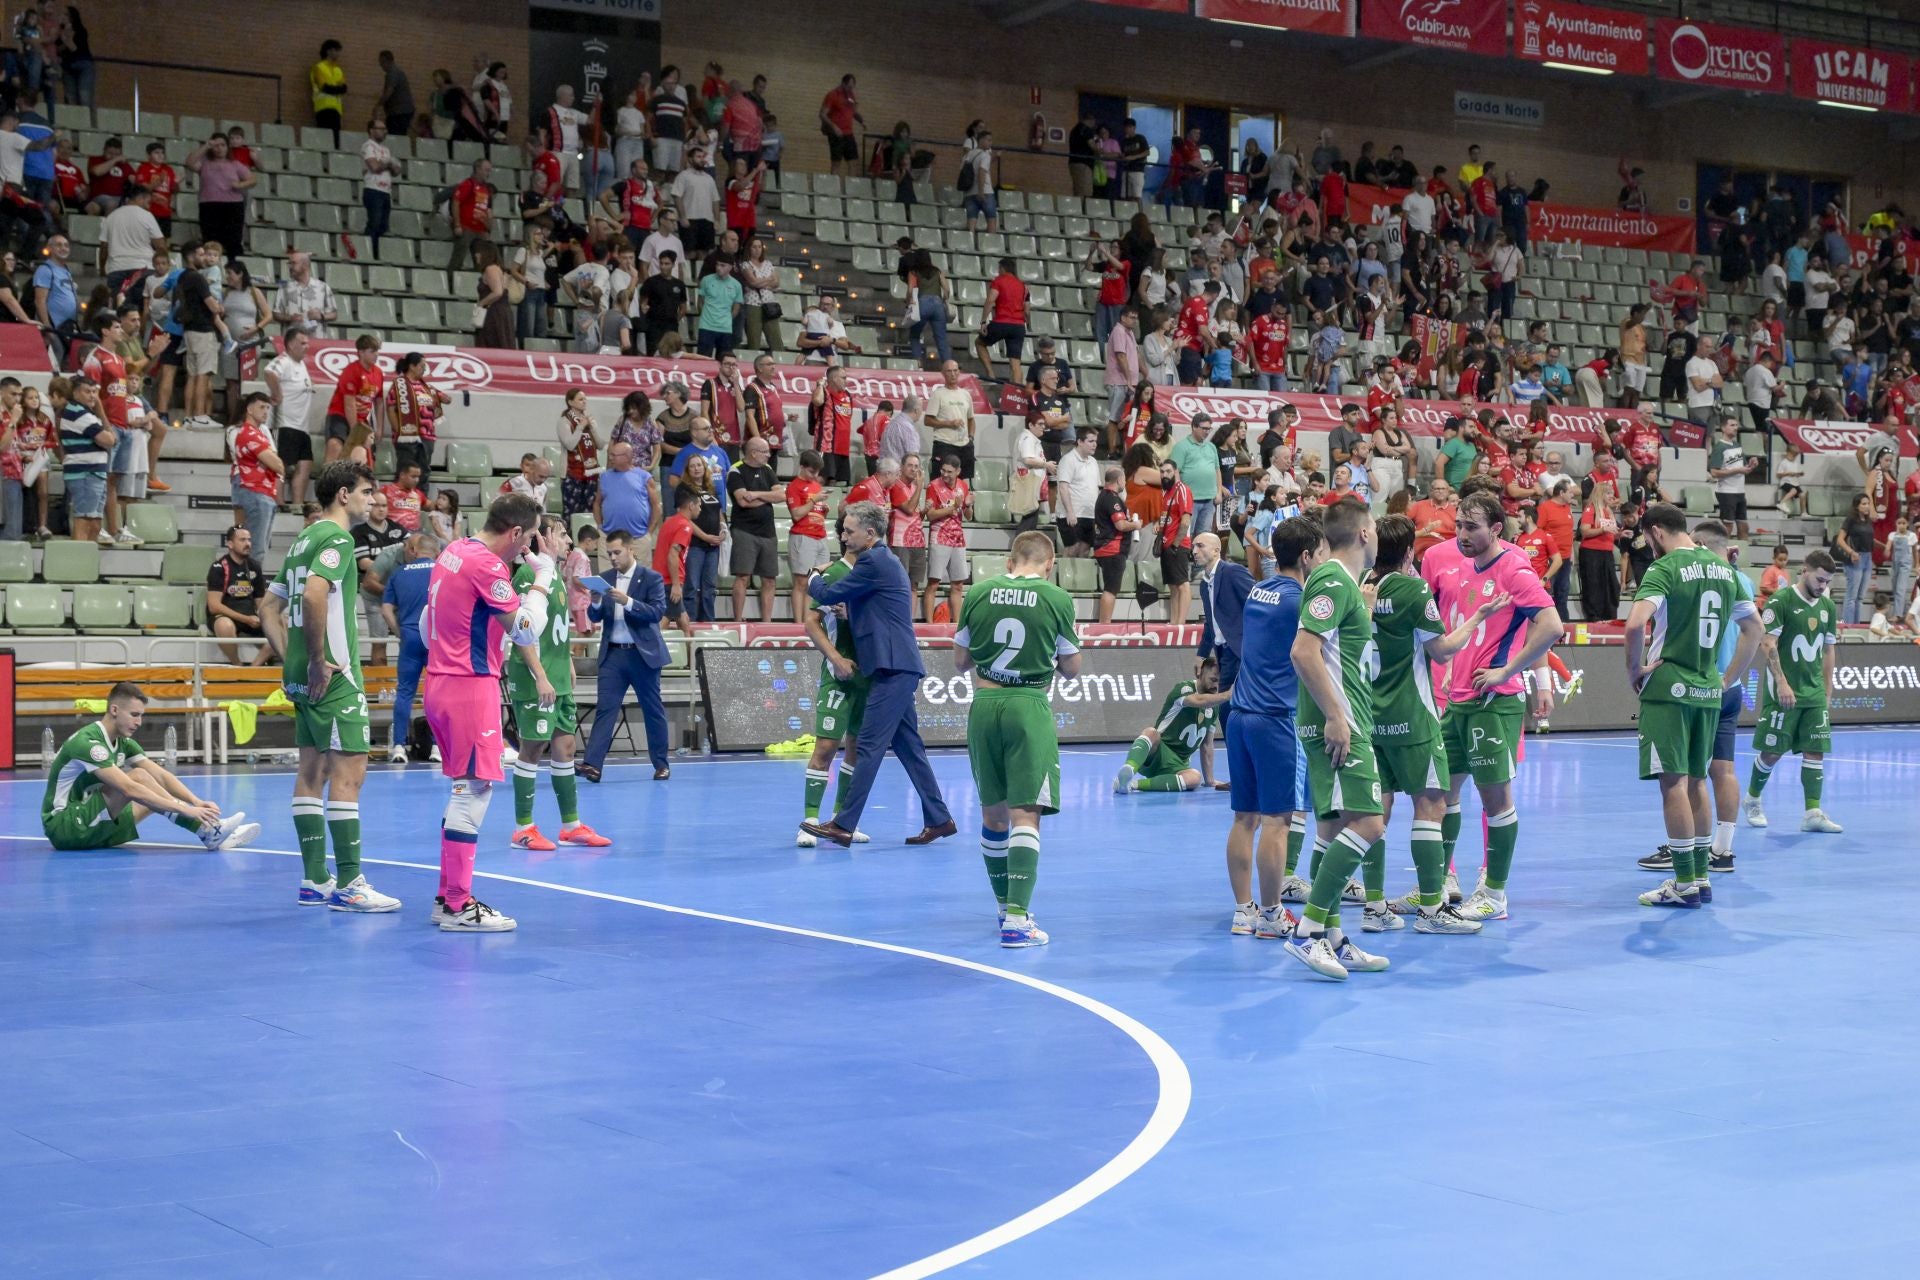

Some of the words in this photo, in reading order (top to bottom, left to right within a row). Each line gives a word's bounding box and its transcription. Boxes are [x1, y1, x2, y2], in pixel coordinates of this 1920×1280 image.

[1545, 11, 1643, 41] Ayuntamiento
[1547, 41, 1565, 57] de
[1567, 43, 1617, 65] Murcia
[1814, 50, 1888, 88] UCAM
[1816, 81, 1887, 105] UNIVERSIDAD
[1458, 100, 1500, 116] Grada
[1504, 104, 1540, 120] Norte
[1536, 207, 1659, 236] Ayuntamiento
[1387, 227, 1399, 244] 10
[526, 355, 617, 384] Uno
[633, 362, 704, 389] más
[779, 371, 812, 395] la
[1680, 561, 1705, 583] RAÚL
[989, 587, 1038, 608] CECILIO
[1373, 598, 1393, 614] HA
[1699, 590, 1722, 649] 6
[993, 617, 1026, 677] 2
[827, 689, 846, 710] 17
[1378, 724, 1386, 736] DE
[1387, 722, 1410, 736] ARDOZ
[1770, 710, 1785, 730] 11
